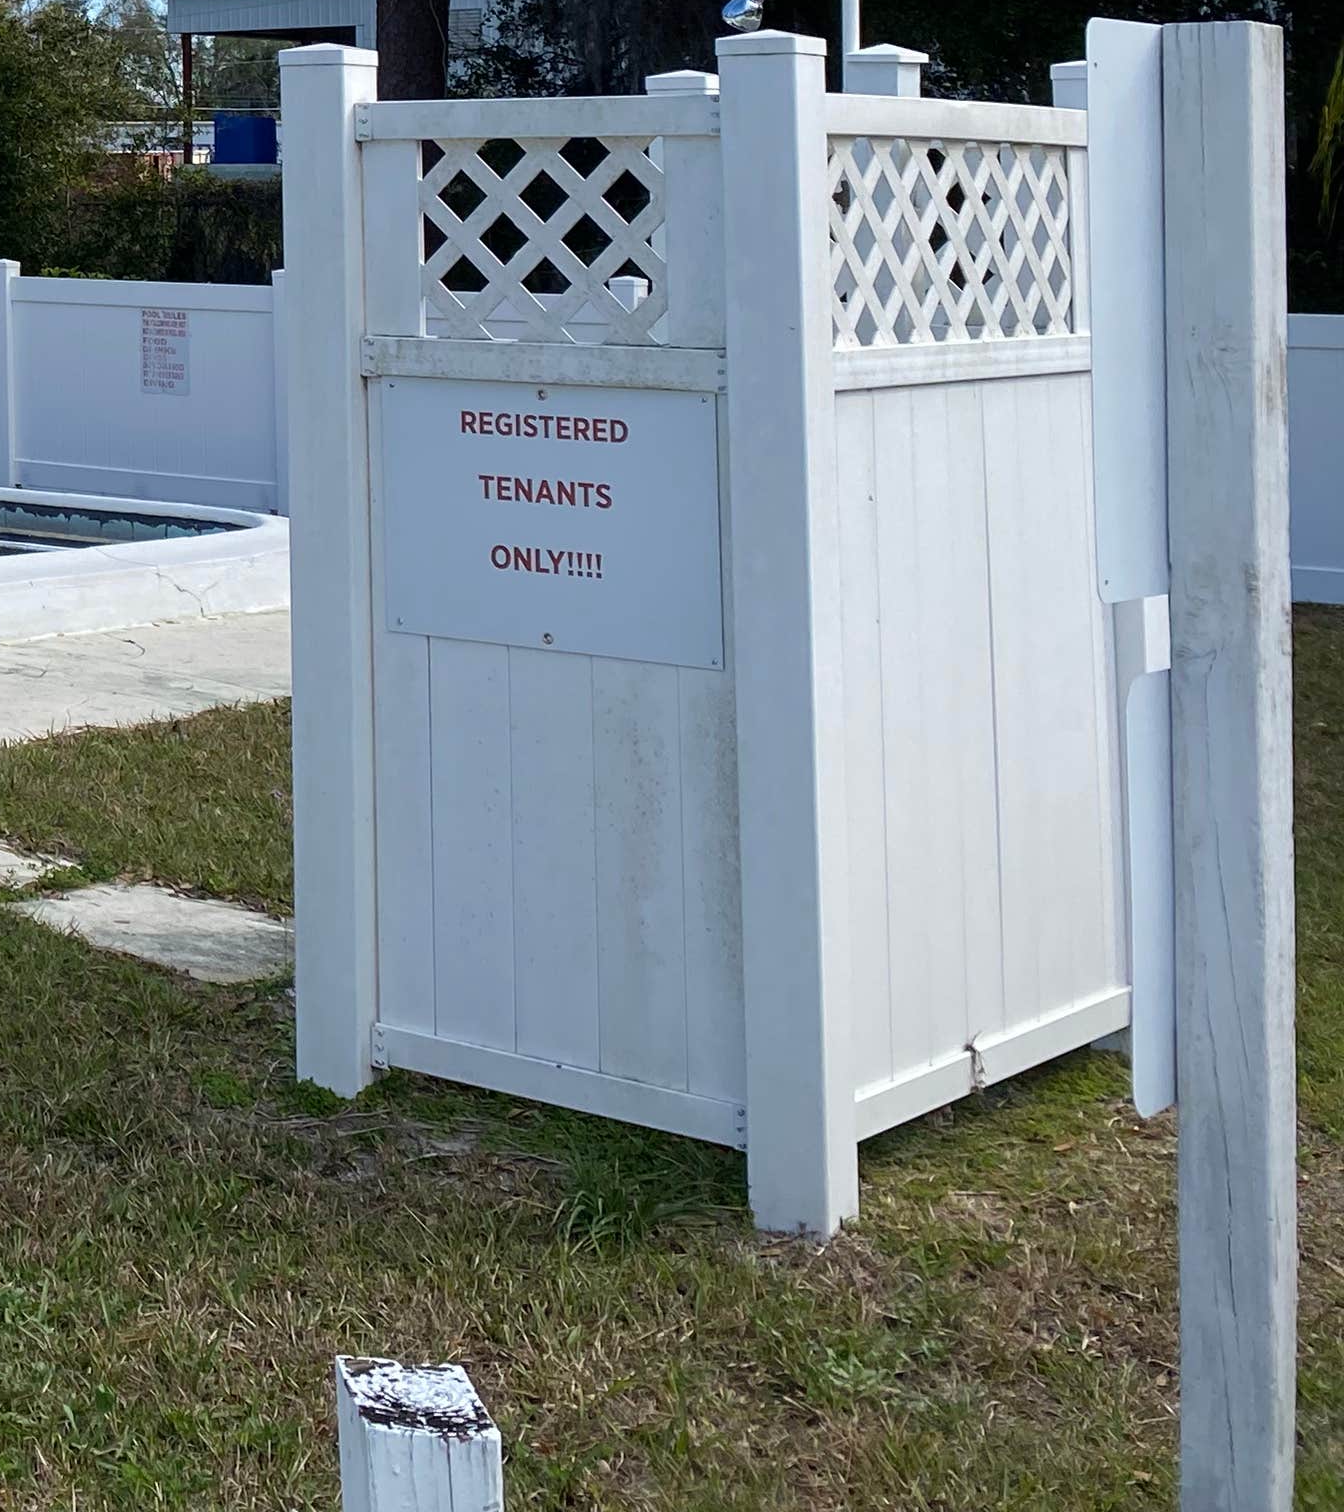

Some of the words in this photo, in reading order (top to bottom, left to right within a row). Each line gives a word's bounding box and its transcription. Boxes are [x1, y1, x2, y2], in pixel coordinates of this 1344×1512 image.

[460, 410, 629, 443] REGISTERED
[478, 474, 613, 509] TENANTS
[490, 544, 603, 579] ONLY!!!!
